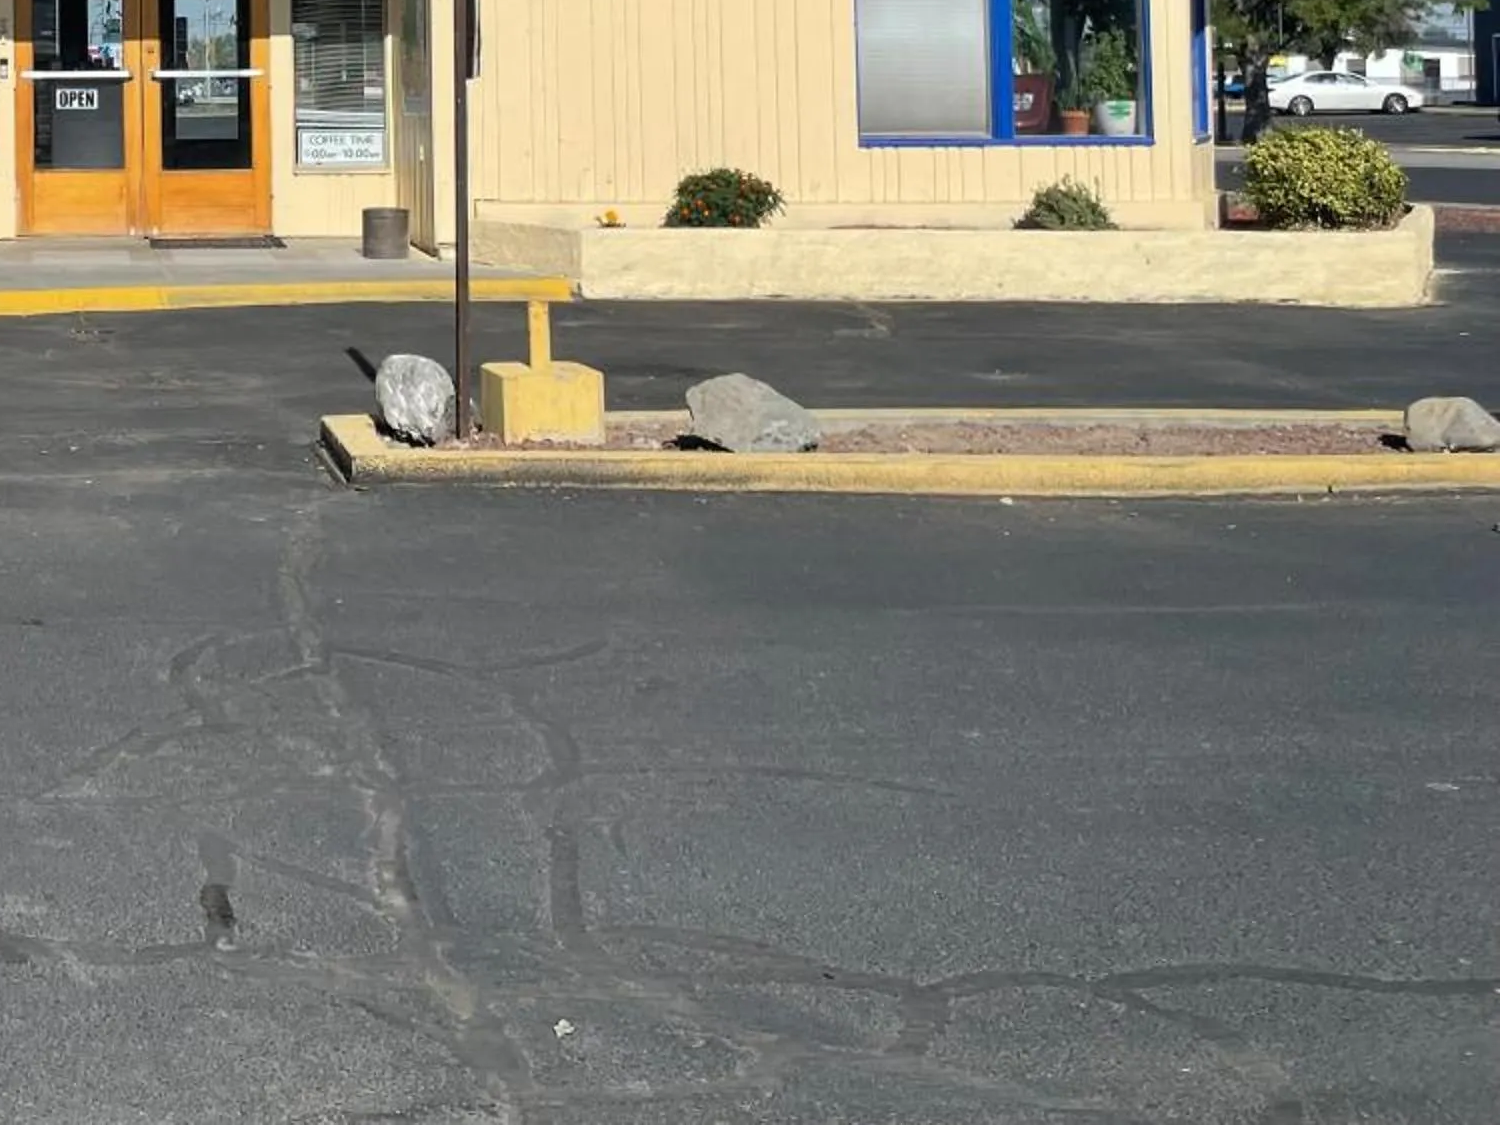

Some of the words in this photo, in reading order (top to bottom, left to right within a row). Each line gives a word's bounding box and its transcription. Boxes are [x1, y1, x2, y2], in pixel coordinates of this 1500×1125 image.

[59, 90, 95, 108] OPEN
[309, 134, 346, 146] COFFEE
[349, 134, 375, 145] TIME
